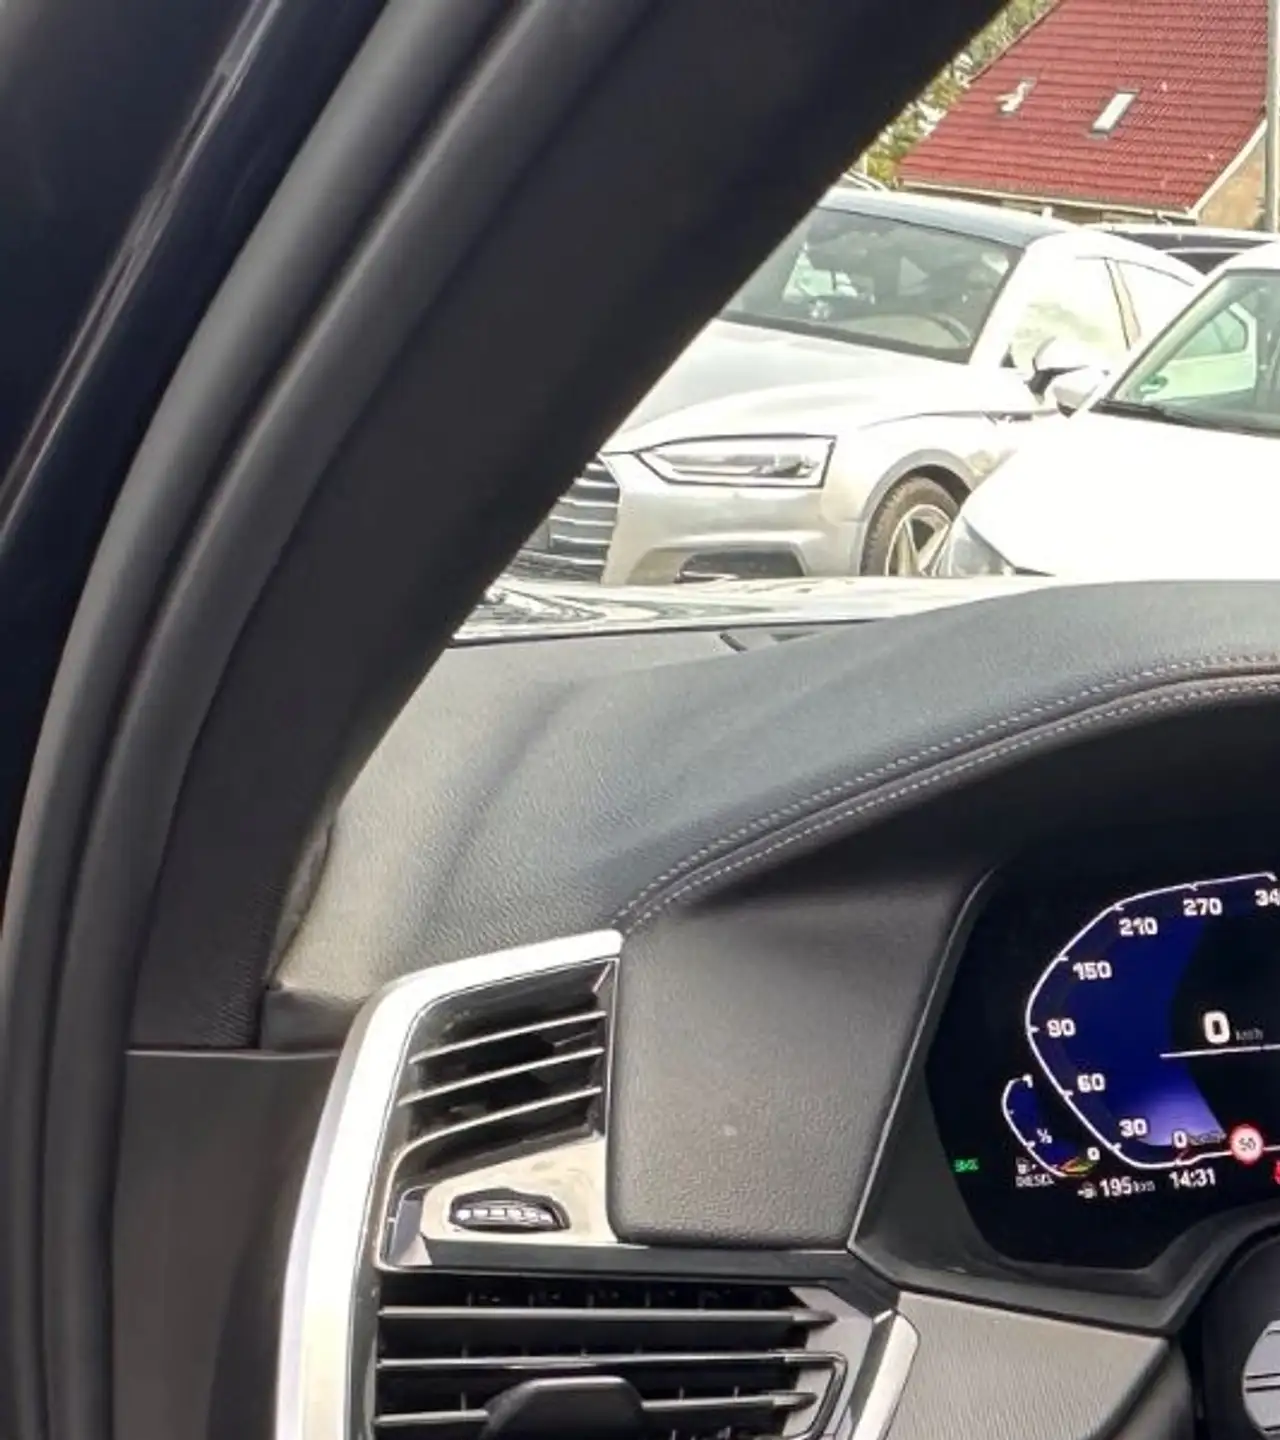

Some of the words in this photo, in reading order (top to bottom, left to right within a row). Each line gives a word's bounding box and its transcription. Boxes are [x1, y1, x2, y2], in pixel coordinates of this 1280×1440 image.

[1183, 898, 1223, 917] 270
[1118, 917, 1159, 937] 210
[1072, 961, 1112, 980] 150
[1046, 1018, 1077, 1038] 90
[1203, 1011, 1230, 1044] 0
[1076, 1073, 1106, 1092] 60
[1118, 1118, 1149, 1138] 30
[1173, 1130, 1188, 1149] 0
[1238, 1136, 1258, 1152] 50
[1086, 1145, 1101, 1162] 0
[1099, 1175, 1132, 1198] 195
[1169, 1166, 1217, 1190] 14:31
